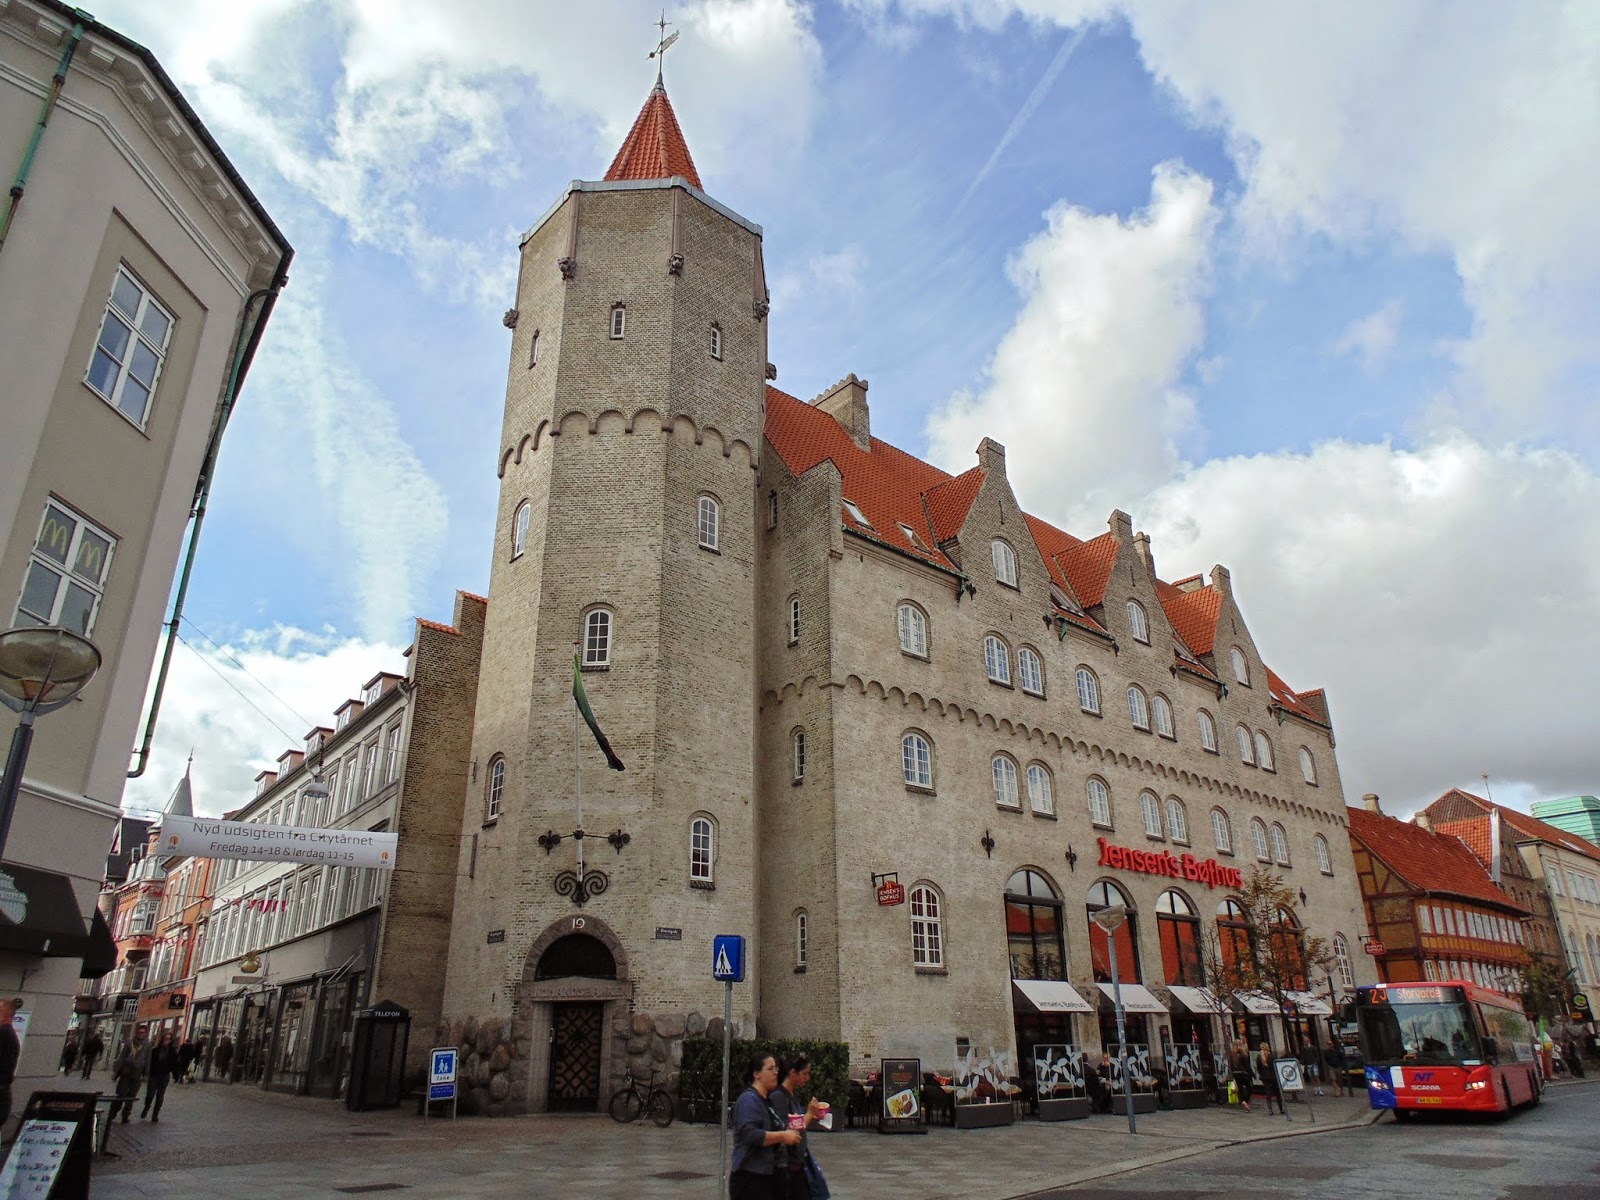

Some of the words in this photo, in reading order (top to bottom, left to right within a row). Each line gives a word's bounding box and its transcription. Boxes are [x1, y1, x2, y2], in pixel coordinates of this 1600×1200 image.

[193, 822, 221, 836] Nyd
[224, 825, 284, 841] udsigten
[288, 830, 306, 841] fra
[310, 832, 374, 846] Citytårnet
[209, 841, 249, 855] Fredag
[251, 845, 281, 856] 14-18
[282, 847, 291, 857] &
[292, 847, 325, 860] lørdag
[327, 851, 354, 861] 11-15
[1097, 837, 1181, 878] Jensen's
[1181, 853, 1245, 890] Bøfhus
[572, 917, 586, 929] 19
[1396, 987, 1441, 999] Storvorde
